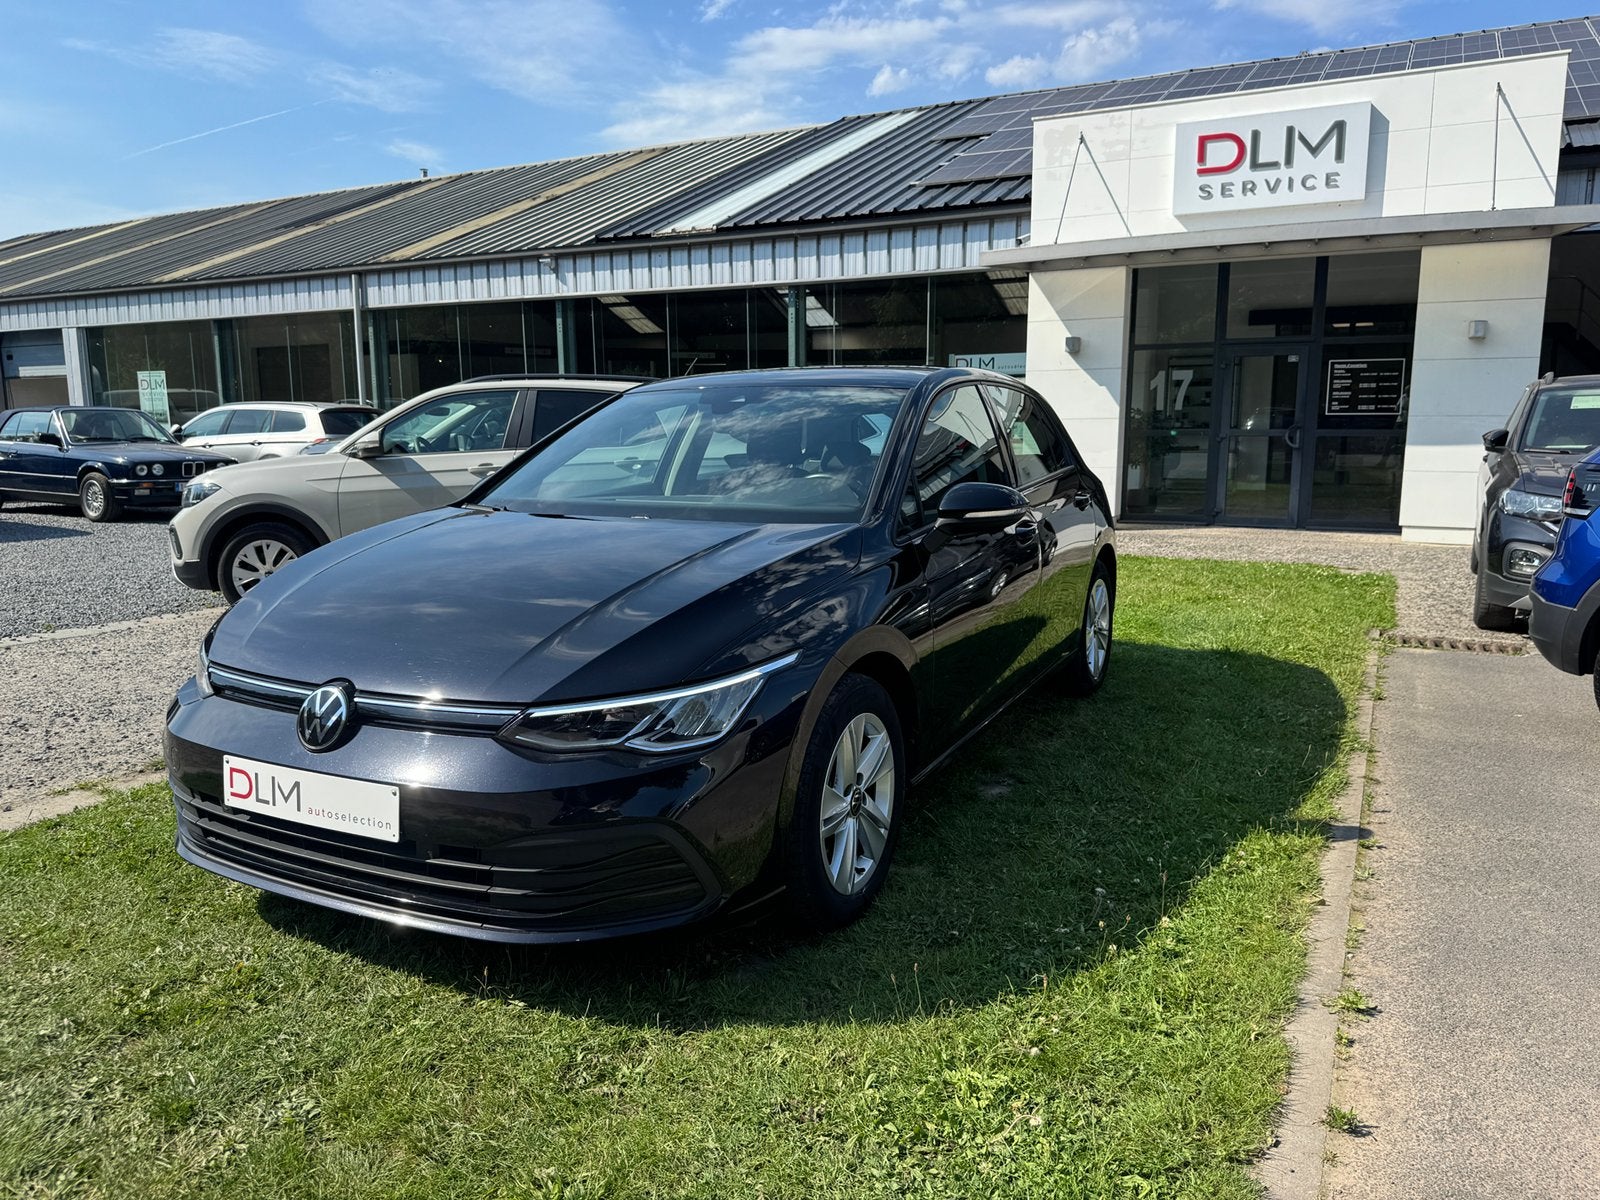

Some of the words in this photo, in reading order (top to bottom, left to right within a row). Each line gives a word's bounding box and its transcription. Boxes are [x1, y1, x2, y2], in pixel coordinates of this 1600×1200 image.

[1197, 120, 1347, 176] DLM
[1198, 172, 1341, 200] SERVICE
[140, 379, 166, 391] DLM
[1150, 369, 1194, 411] 17
[229, 766, 301, 812] DLM
[307, 806, 392, 830] autoselection
